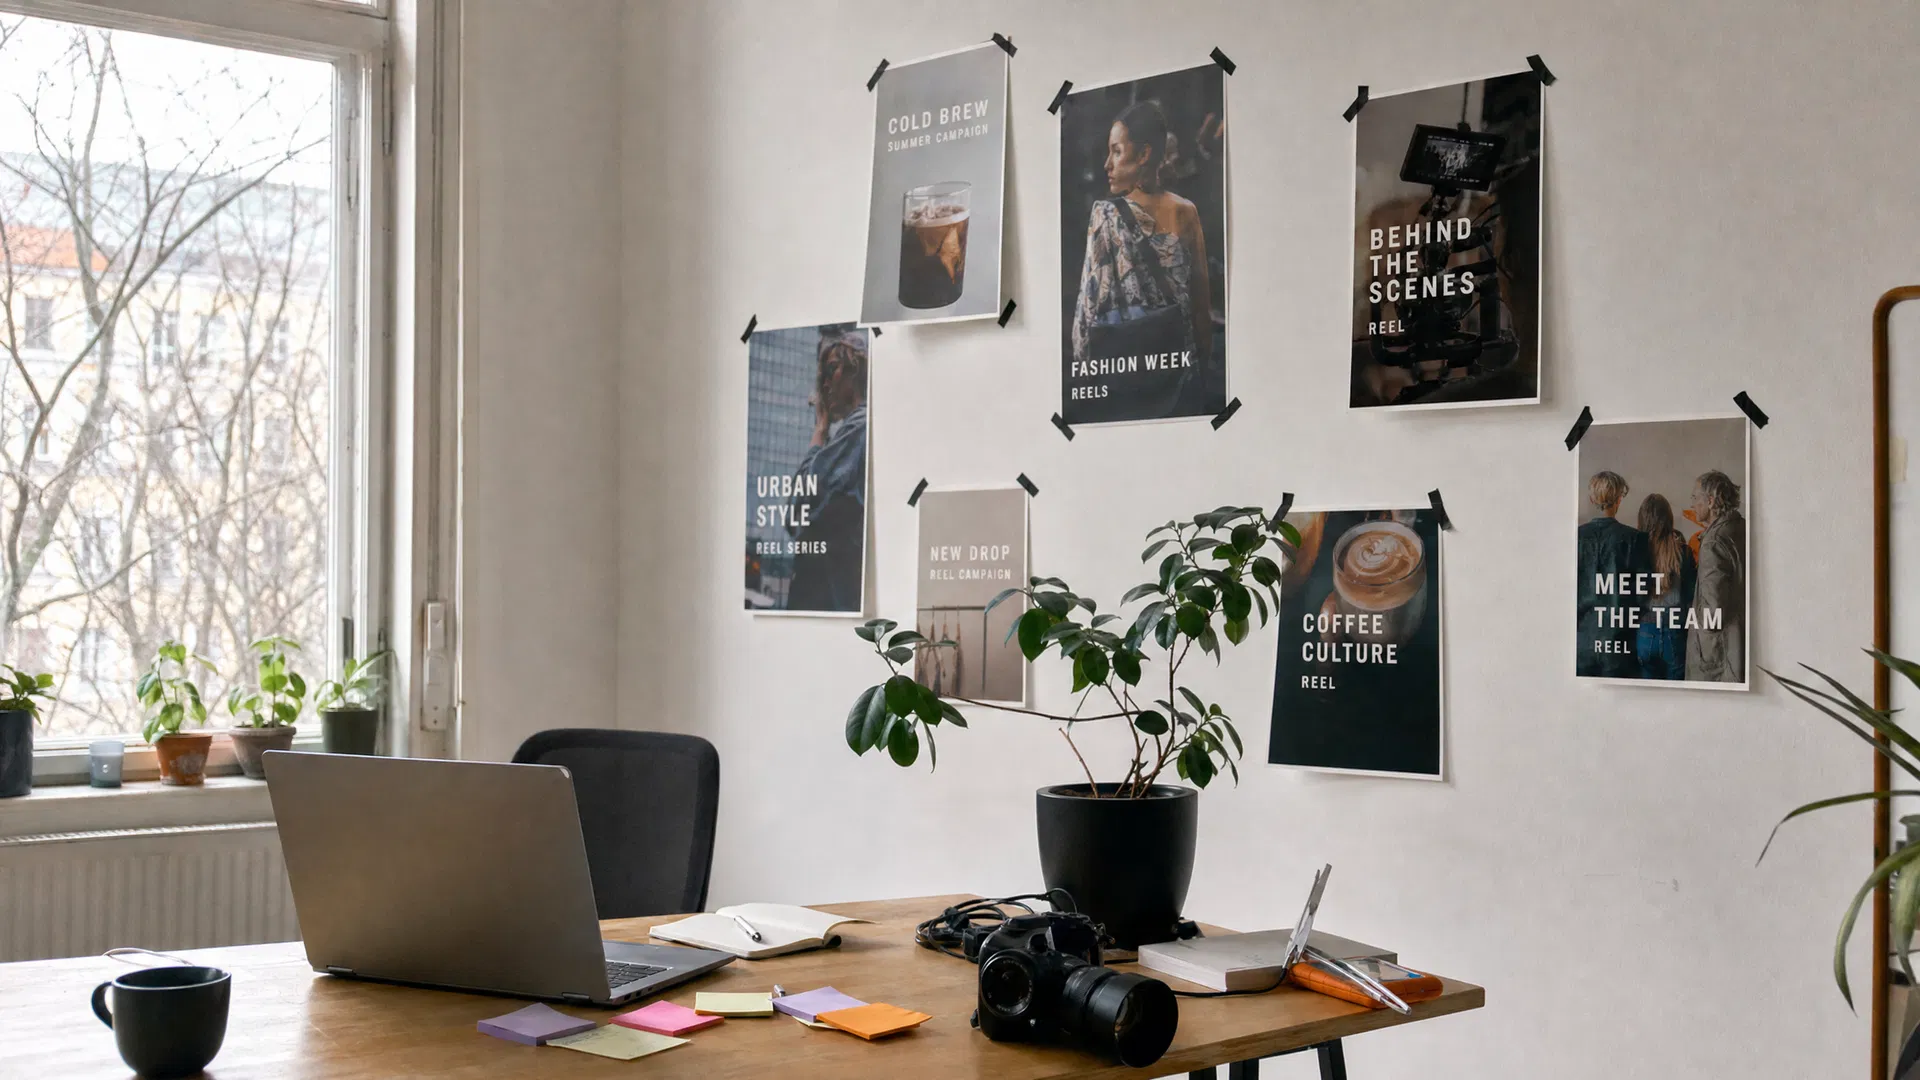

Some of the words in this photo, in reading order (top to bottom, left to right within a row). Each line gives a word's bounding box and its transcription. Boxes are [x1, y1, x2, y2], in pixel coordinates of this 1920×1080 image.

[888, 111, 932, 134] COLD
[939, 99, 989, 125] BREW
[887, 135, 931, 152] SUMMER
[936, 124, 988, 143] CAMPAIGN
[1370, 217, 1472, 251] BEHIND
[1370, 251, 1419, 277] THE
[1369, 271, 1475, 304] SCENES
[1368, 320, 1405, 336] REEL
[1071, 357, 1138, 377] FASHION
[1145, 351, 1191, 370] WEEK
[1071, 385, 1108, 400] REELS
[757, 474, 818, 498] URBAN
[756, 504, 811, 527] STYLE
[756, 541, 782, 555] REEL
[787, 541, 827, 555] SERIES
[930, 545, 962, 561] NEW
[969, 544, 1010, 561] DROP
[929, 569, 954, 580] REEL
[958, 568, 1011, 580] CAMPAIGN
[1595, 572, 1666, 596] MEET
[1302, 613, 1384, 635] COFFEE
[1594, 606, 1641, 629] THE
[1652, 607, 1723, 631] TEAM
[1302, 641, 1398, 664] CULTURE
[1594, 639, 1631, 655] REEL
[1301, 674, 1336, 690] REEL
